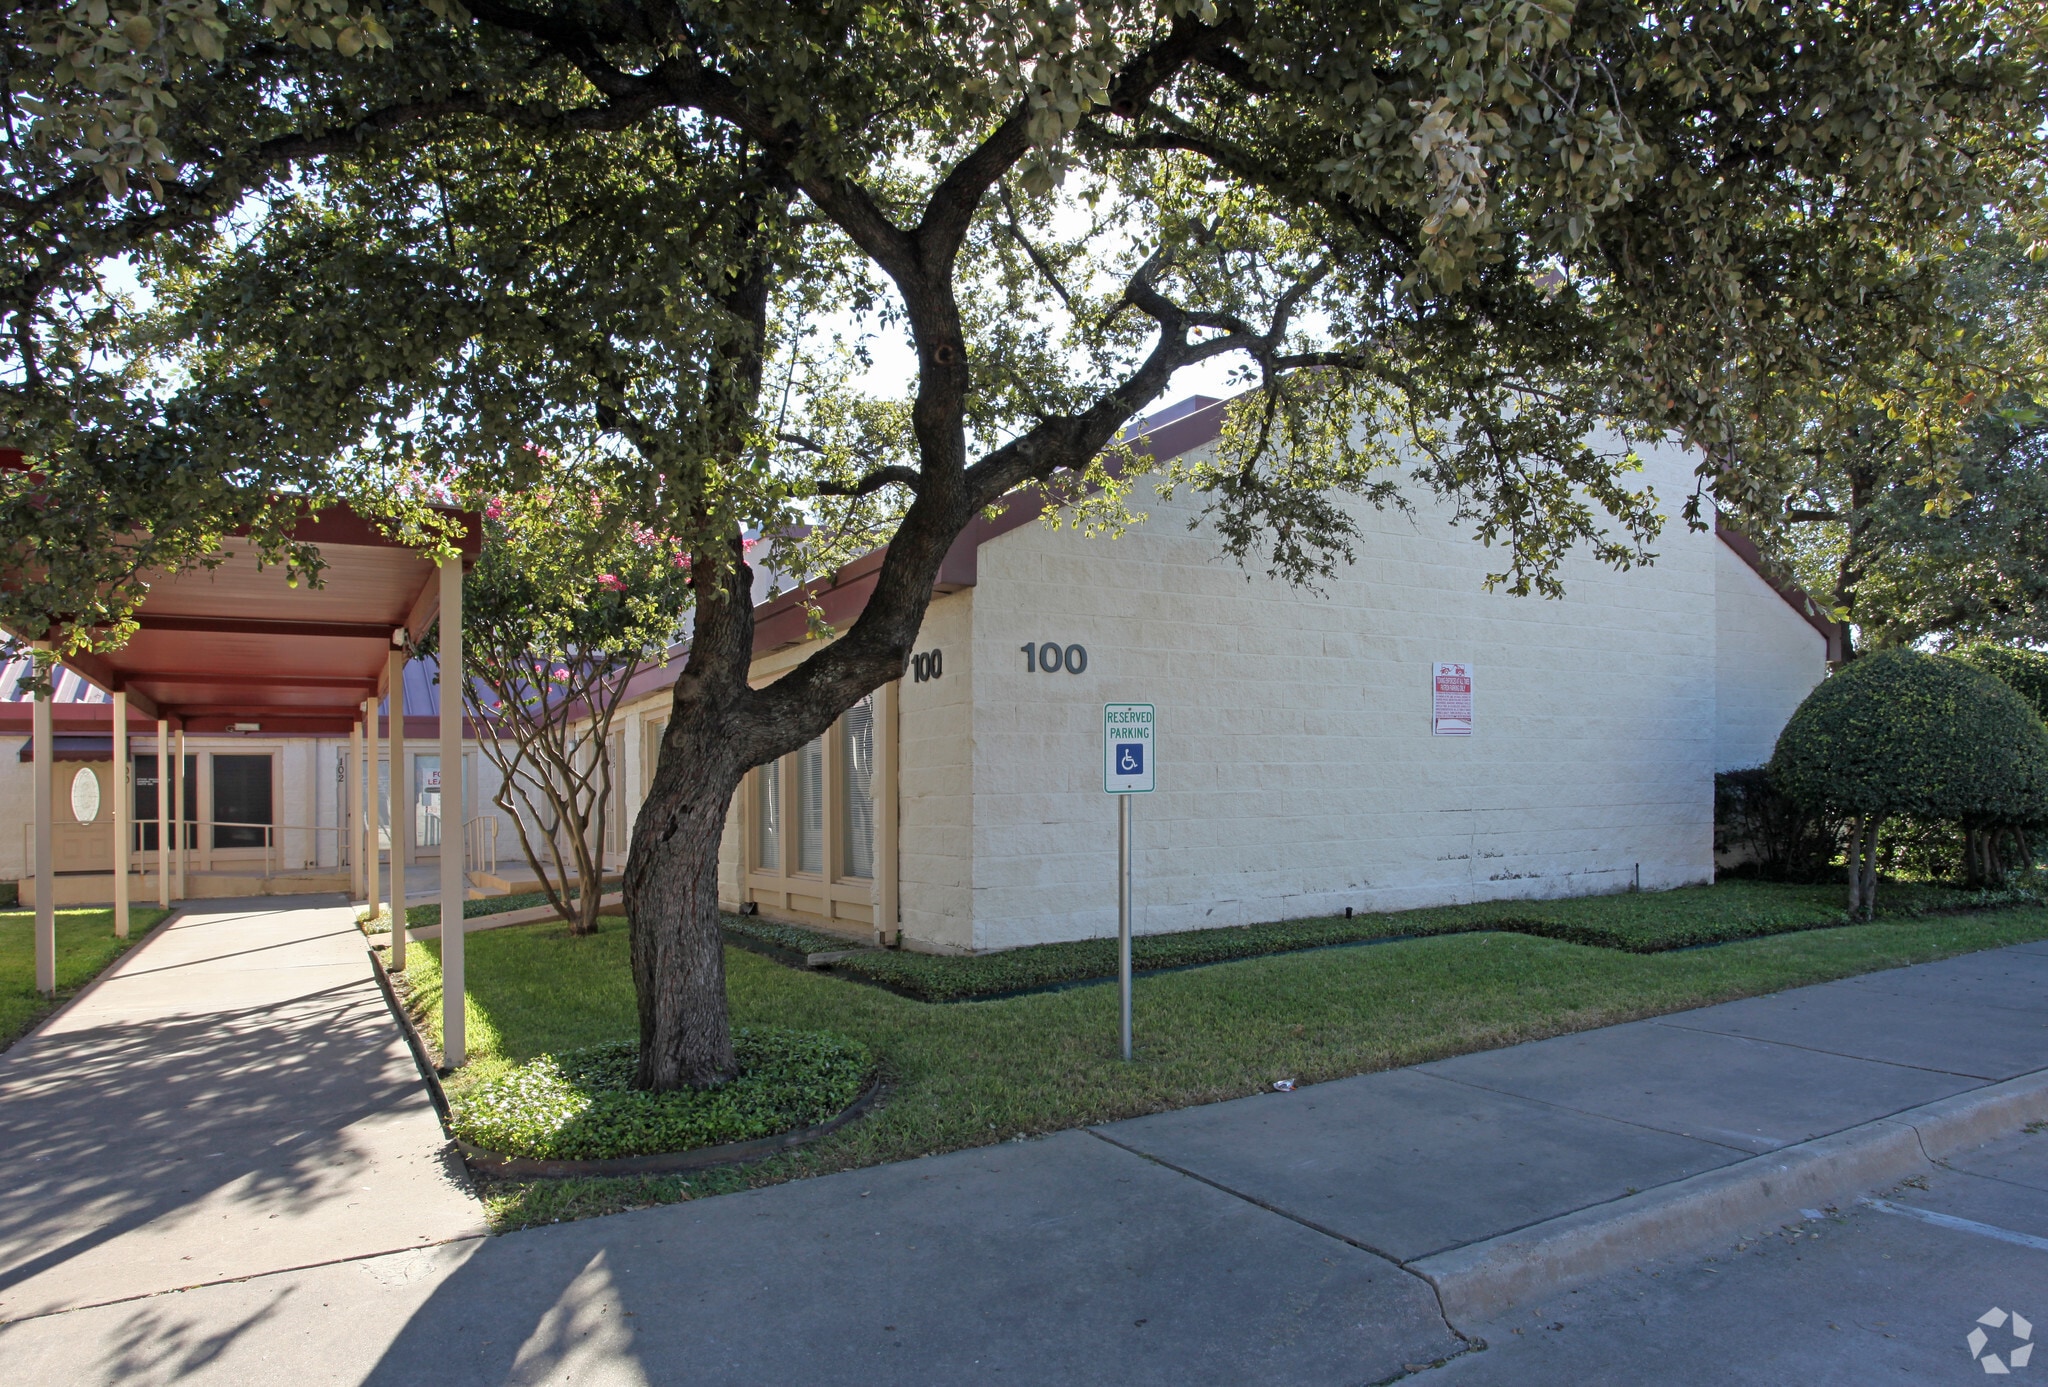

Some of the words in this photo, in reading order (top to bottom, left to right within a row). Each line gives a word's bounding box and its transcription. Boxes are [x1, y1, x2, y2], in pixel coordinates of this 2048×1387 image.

[911, 648, 942, 683] 100
[1021, 641, 1088, 675] 100
[1107, 711, 1152, 723] RESERVED
[1110, 727, 1150, 739] PARKING
